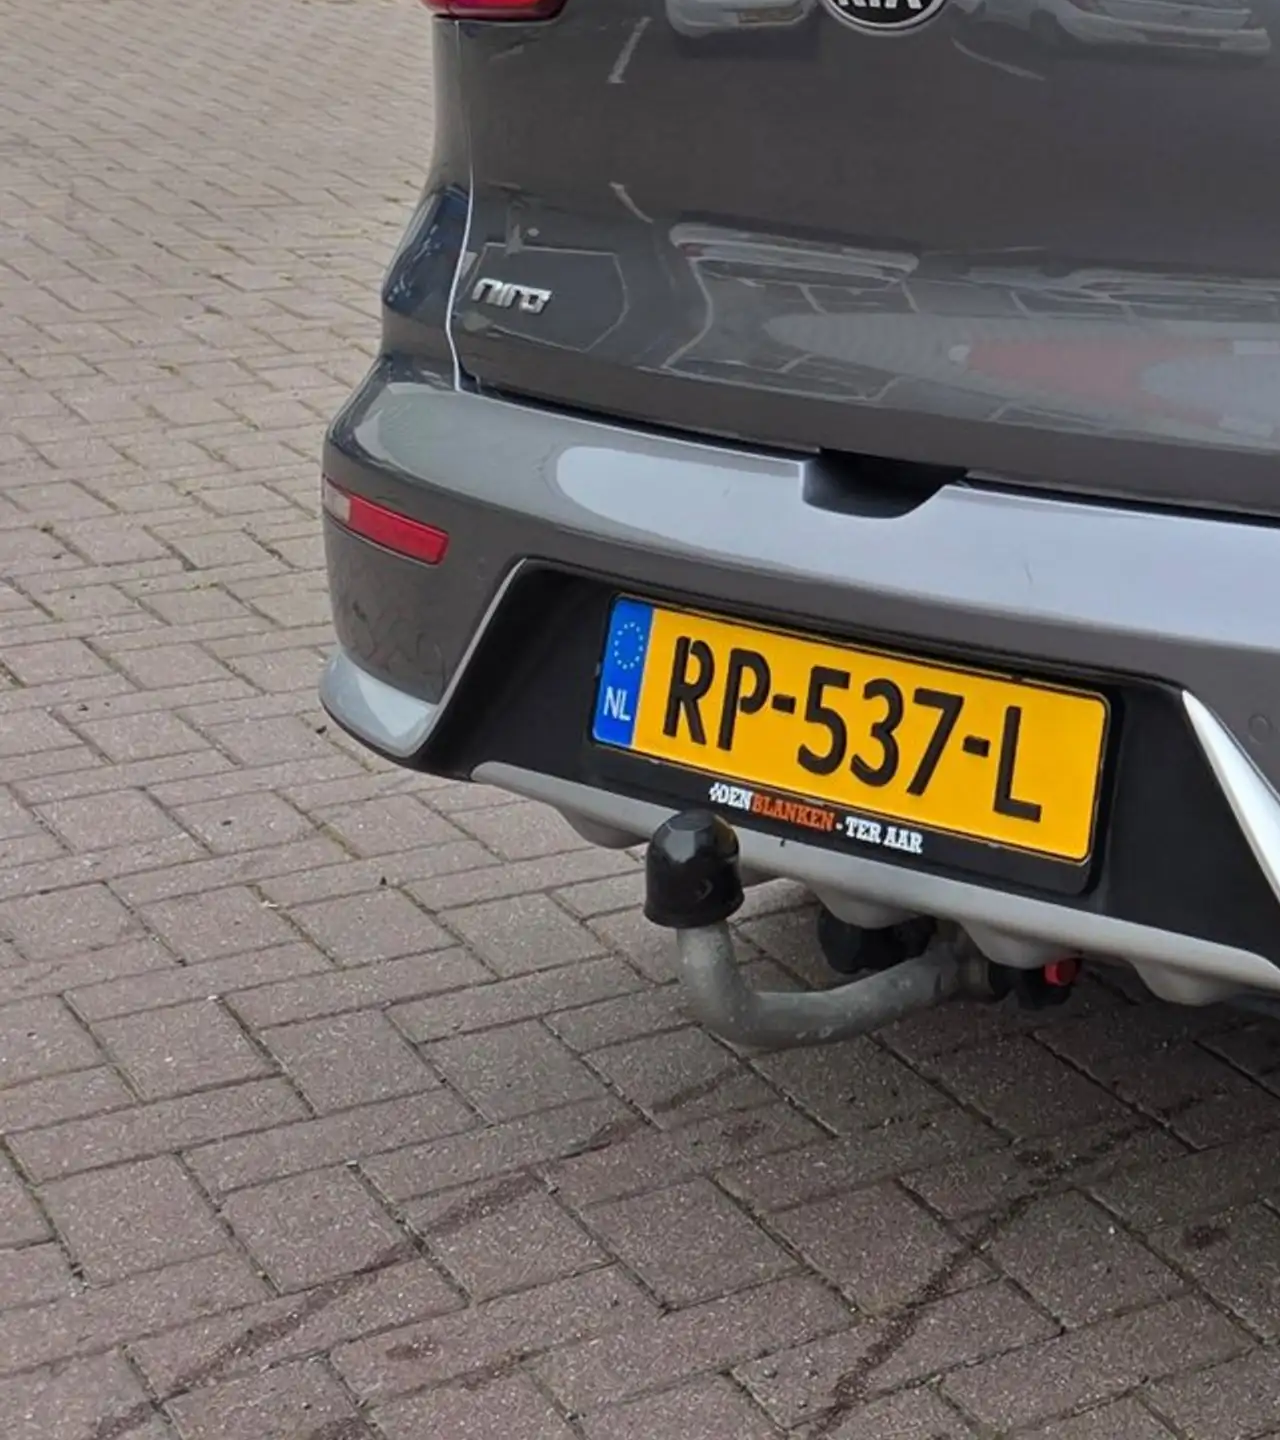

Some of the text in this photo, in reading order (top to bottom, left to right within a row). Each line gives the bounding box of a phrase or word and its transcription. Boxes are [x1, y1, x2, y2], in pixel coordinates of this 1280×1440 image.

[603, 685, 631, 722] NL
[662, 635, 1043, 823] RP-537-L
[845, 815, 882, 844] TER
[883, 825, 924, 855] AAR
